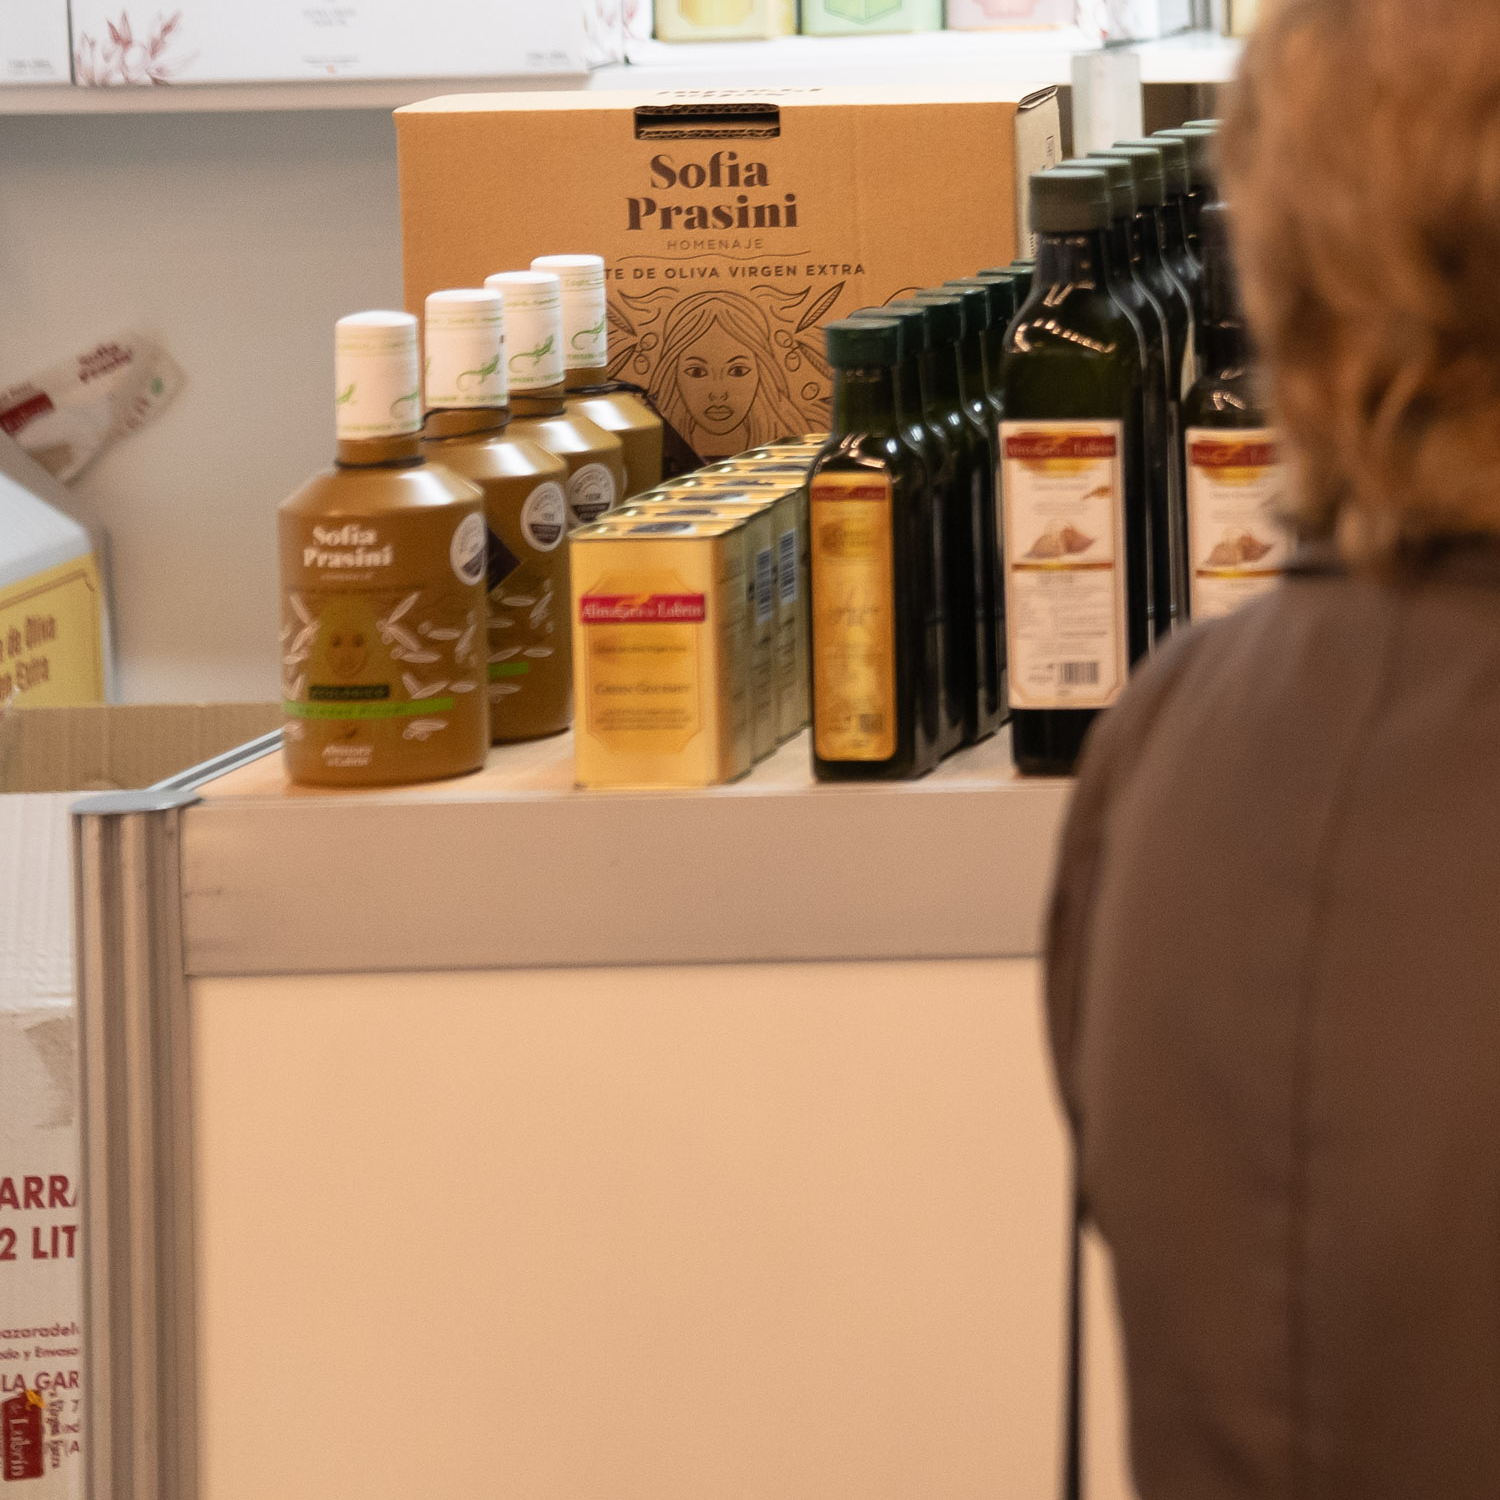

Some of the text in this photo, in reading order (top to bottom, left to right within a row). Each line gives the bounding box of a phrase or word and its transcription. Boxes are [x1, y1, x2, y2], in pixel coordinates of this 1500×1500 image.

[649, 150, 770, 190] Sofia
[625, 193, 798, 230] Prasini
[667, 239, 764, 251] HOMENAJE
[633, 267, 656, 279] DE
[664, 266, 720, 279] OLIVA
[728, 264, 798, 278] VIRGEN
[805, 263, 866, 277] EXTRA
[312, 524, 378, 547] Sofia
[303, 546, 395, 568] Prasini
[0, 1174, 77, 1210] ARR
[0, 1225, 77, 1261] 2 LIT
